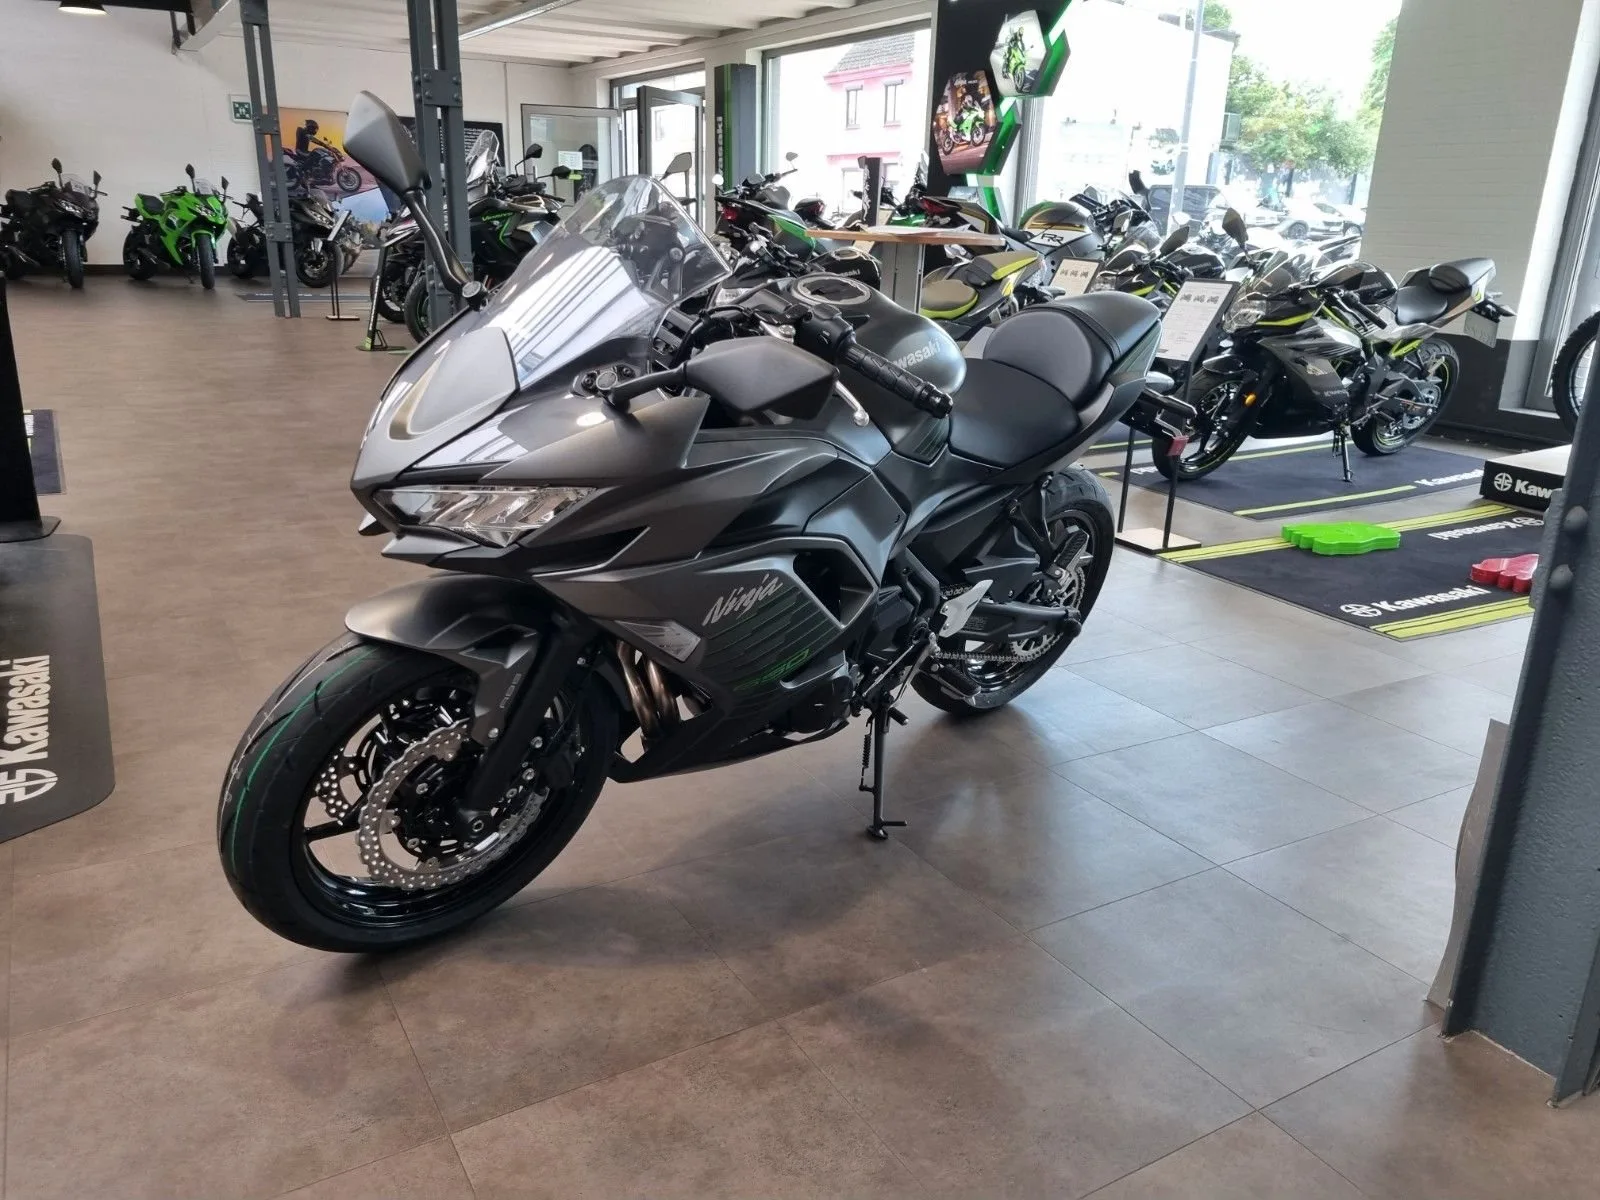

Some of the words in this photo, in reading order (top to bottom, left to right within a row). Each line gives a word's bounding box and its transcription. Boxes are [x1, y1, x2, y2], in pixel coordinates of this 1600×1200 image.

[892, 338, 941, 369] wasaki
[702, 573, 784, 626] Ninja
[1371, 585, 1492, 612] Kawasaki
[0, 655, 51, 766] Kawasaki
